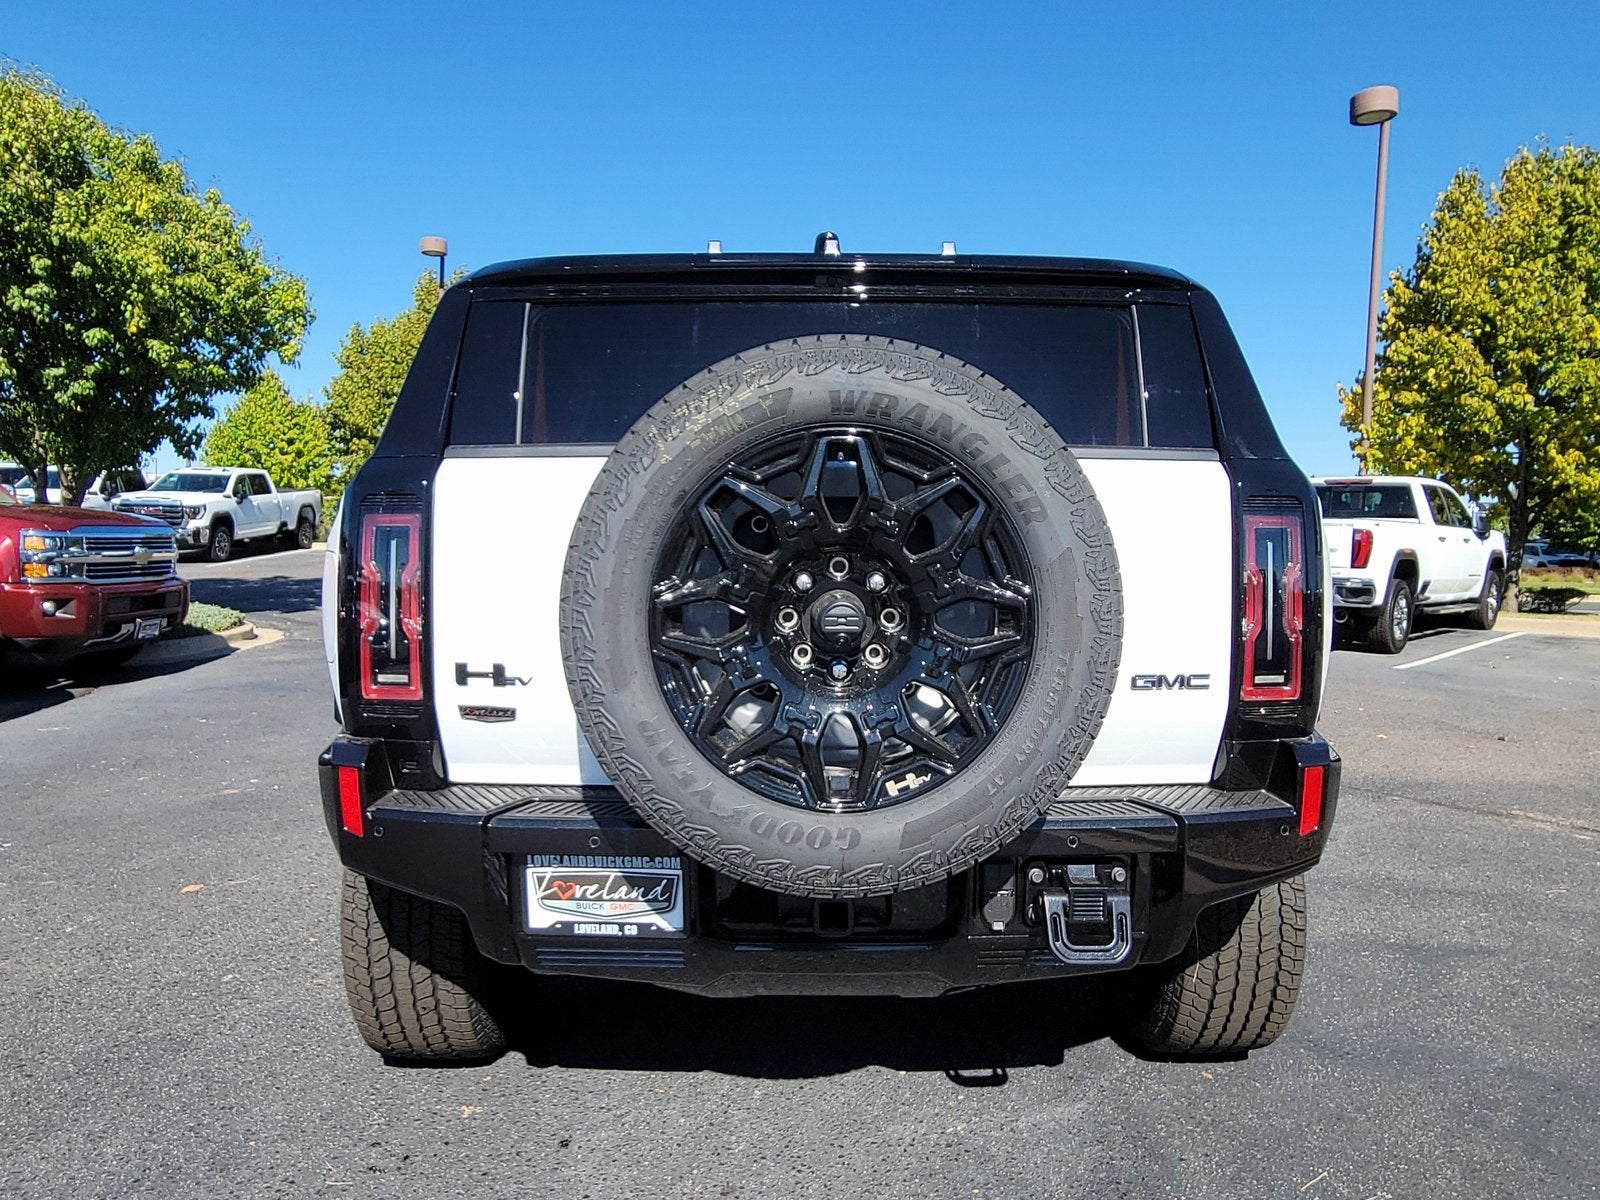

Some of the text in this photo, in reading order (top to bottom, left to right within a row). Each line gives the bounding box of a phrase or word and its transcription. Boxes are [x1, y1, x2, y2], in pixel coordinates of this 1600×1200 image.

[828, 389, 1049, 528] WRANGLER
[1130, 674, 1210, 690] GMC
[535, 871, 671, 901] Loveland
[576, 902, 605, 910] BUICK
[624, 924, 638, 935] CO
